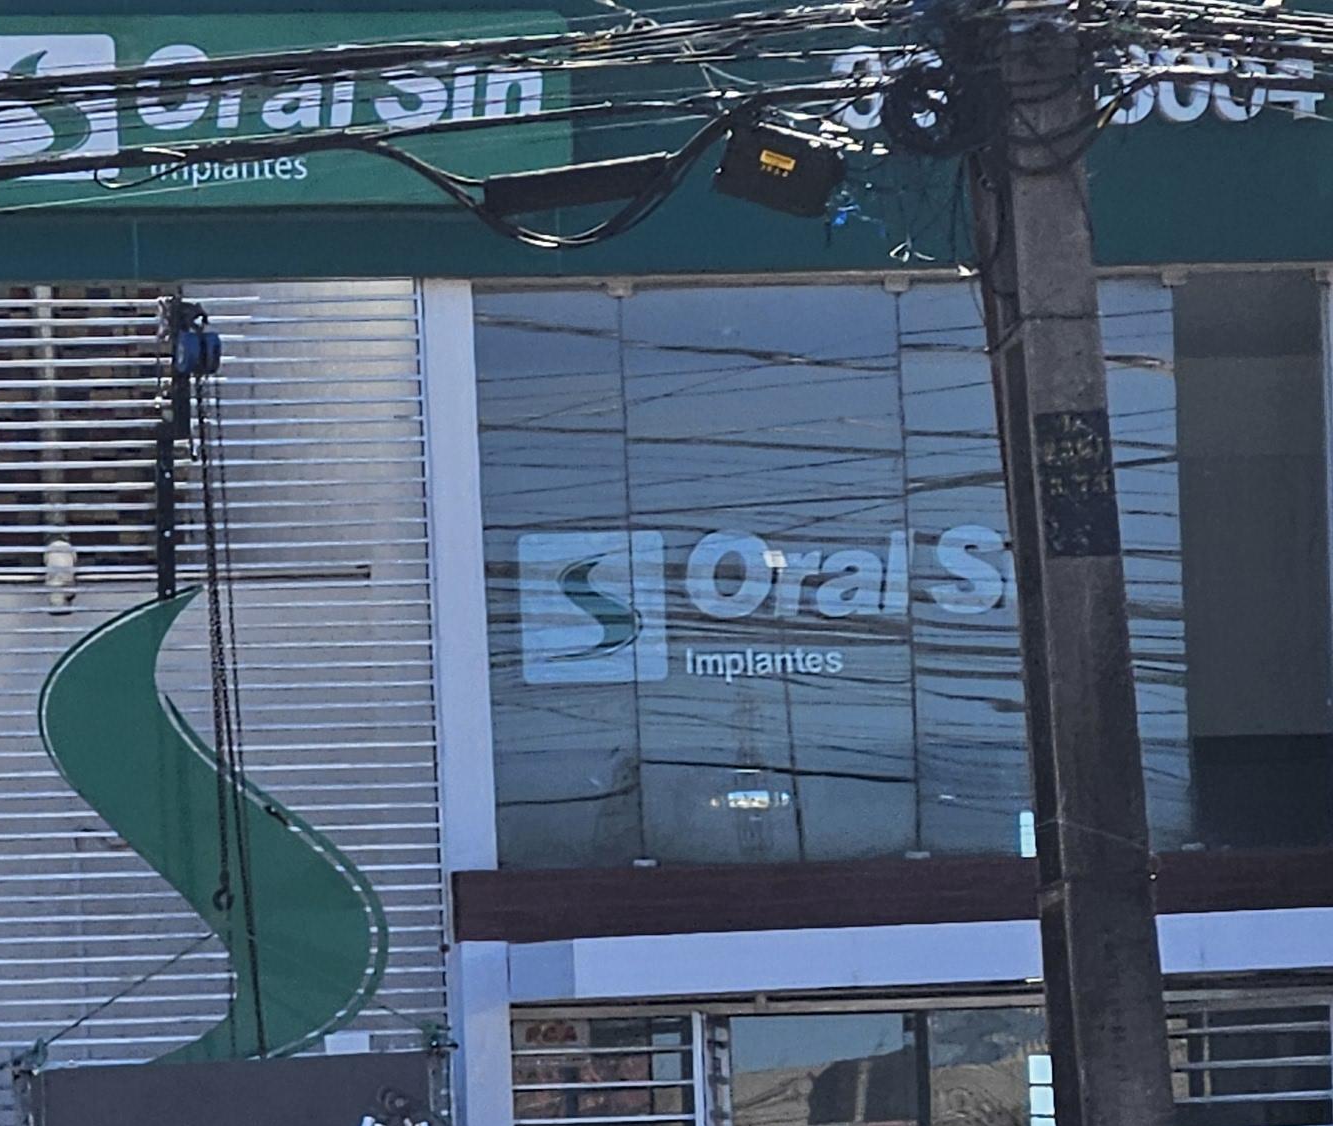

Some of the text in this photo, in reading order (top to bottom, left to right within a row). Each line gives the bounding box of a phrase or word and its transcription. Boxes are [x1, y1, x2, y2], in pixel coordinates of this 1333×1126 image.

[374, 62, 544, 130] Sin
[686, 529, 907, 619] Oral
[685, 647, 844, 683] Implantes
